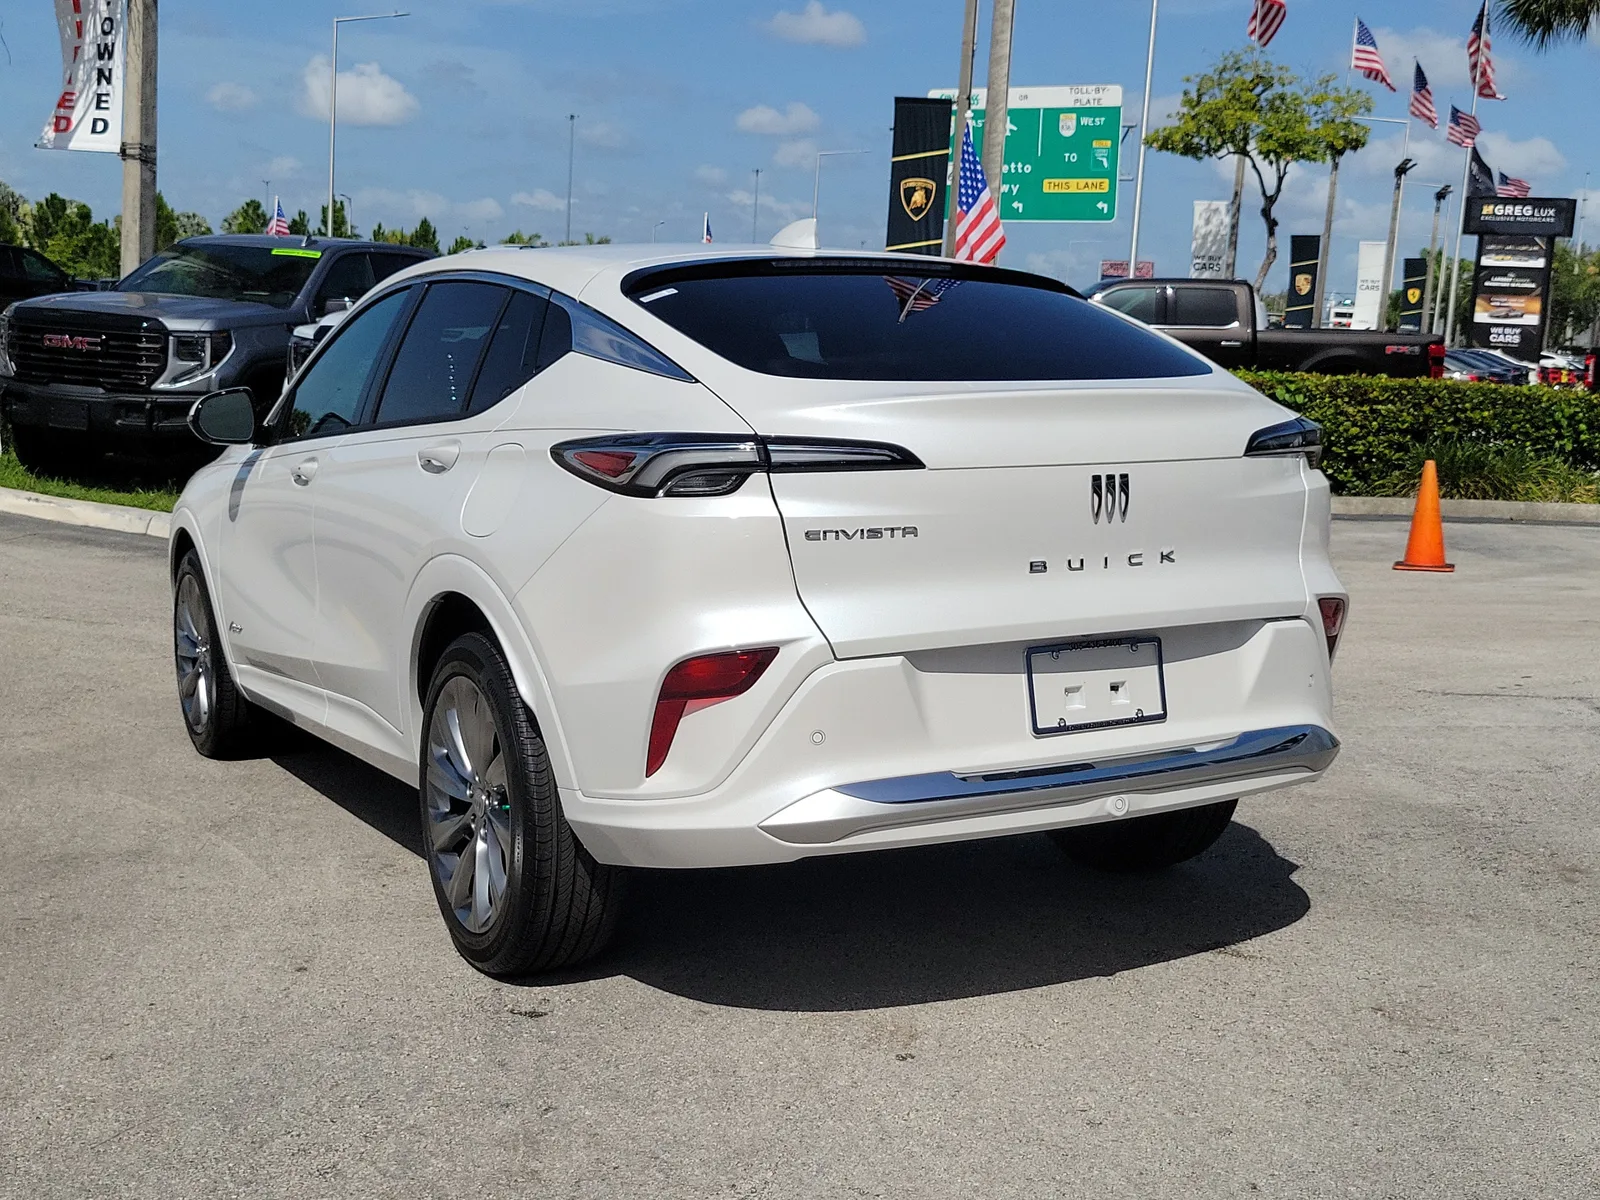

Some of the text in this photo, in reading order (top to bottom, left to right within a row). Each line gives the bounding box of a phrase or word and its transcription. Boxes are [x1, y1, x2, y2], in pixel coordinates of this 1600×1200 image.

[1073, 98, 1103, 106] PLATE
[1080, 116, 1106, 126] WEST
[1063, 152, 1078, 163] TO
[1002, 161, 1032, 174] etto
[1047, 181, 1105, 191] THIS LANE
[1534, 207, 1556, 217] LUX
[1193, 262, 1221, 272] CARS
[1359, 284, 1380, 292] CARS
[1490, 326, 1522, 335] WE BUY
[43, 333, 102, 352] GMC
[1489, 334, 1521, 343] CARS
[804, 525, 919, 541] ENVISTA
[1028, 549, 1177, 574] BUICK
